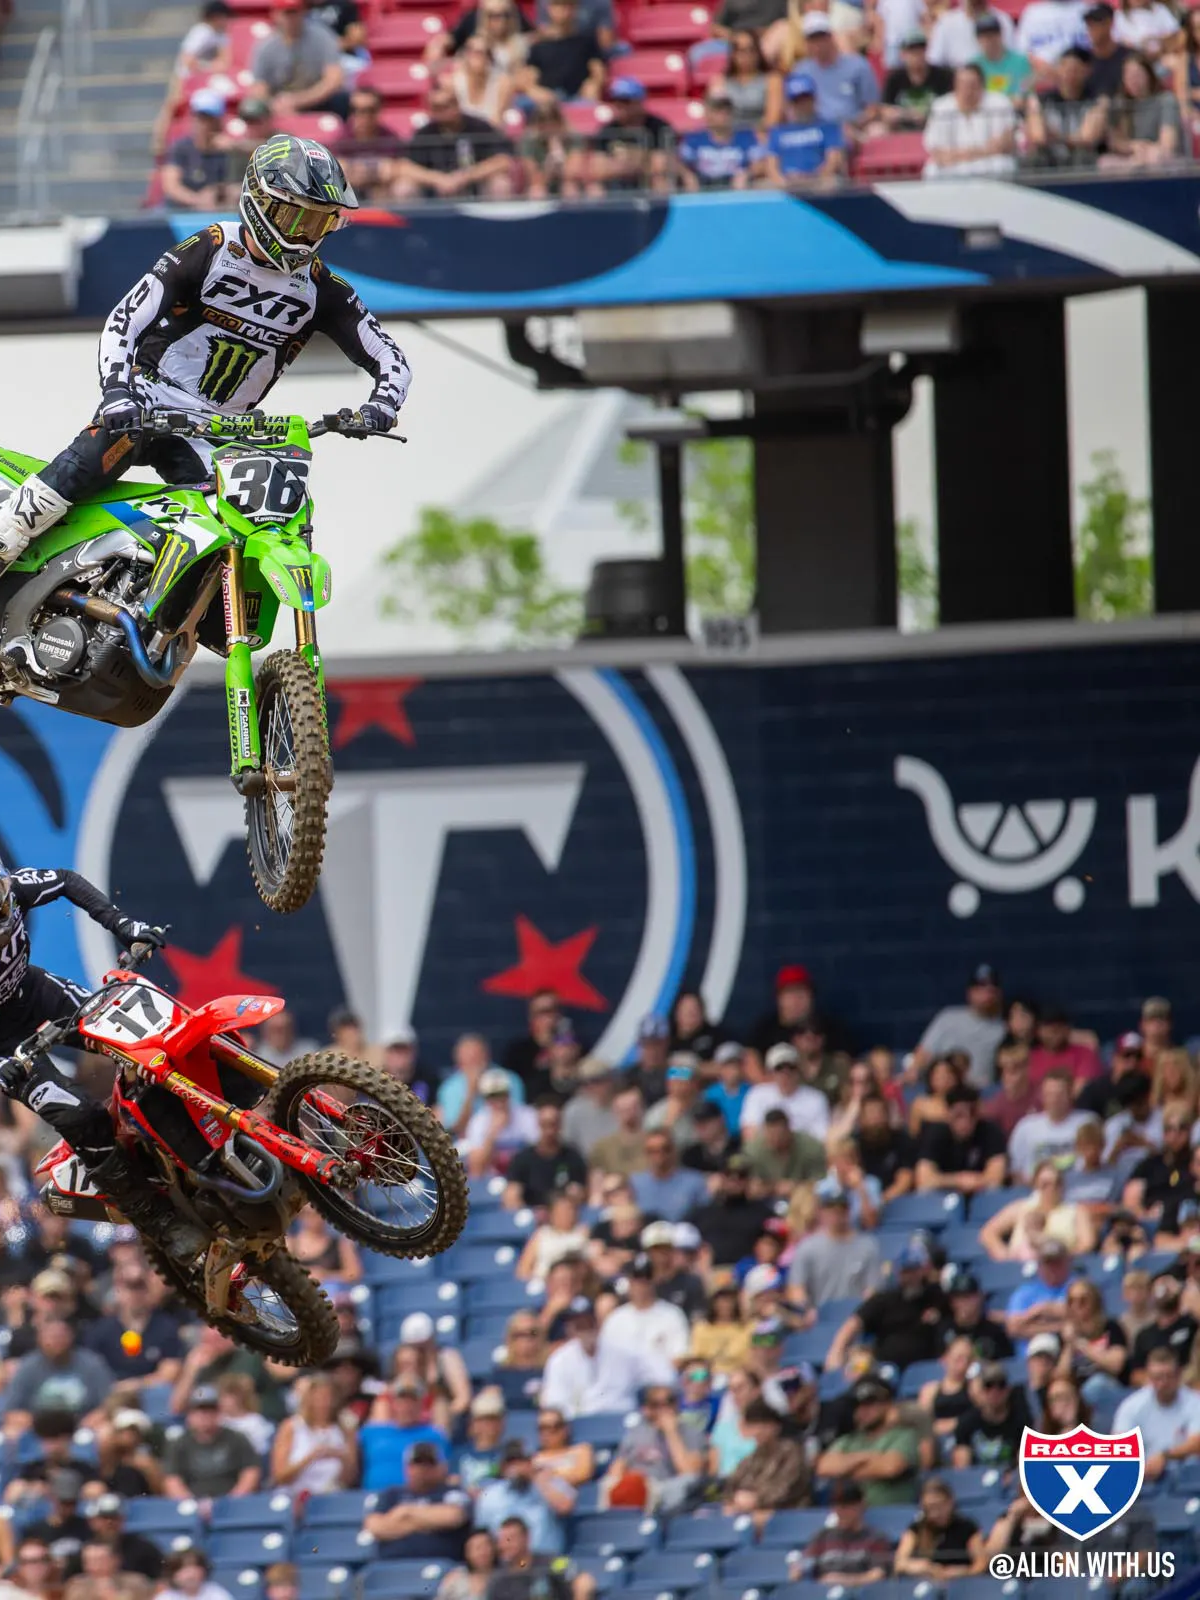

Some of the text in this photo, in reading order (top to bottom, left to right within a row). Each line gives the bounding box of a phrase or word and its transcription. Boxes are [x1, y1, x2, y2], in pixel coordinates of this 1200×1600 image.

[108, 280, 151, 338] FXR
[203, 275, 311, 326] FXR
[206, 309, 288, 346] PRO RACE
[146, 496, 202, 524] KX
[226, 459, 309, 515] 36
[42, 631, 75, 649] Kawasaki
[242, 715, 251, 758] CARRILLO
[106, 986, 164, 1040] 17
